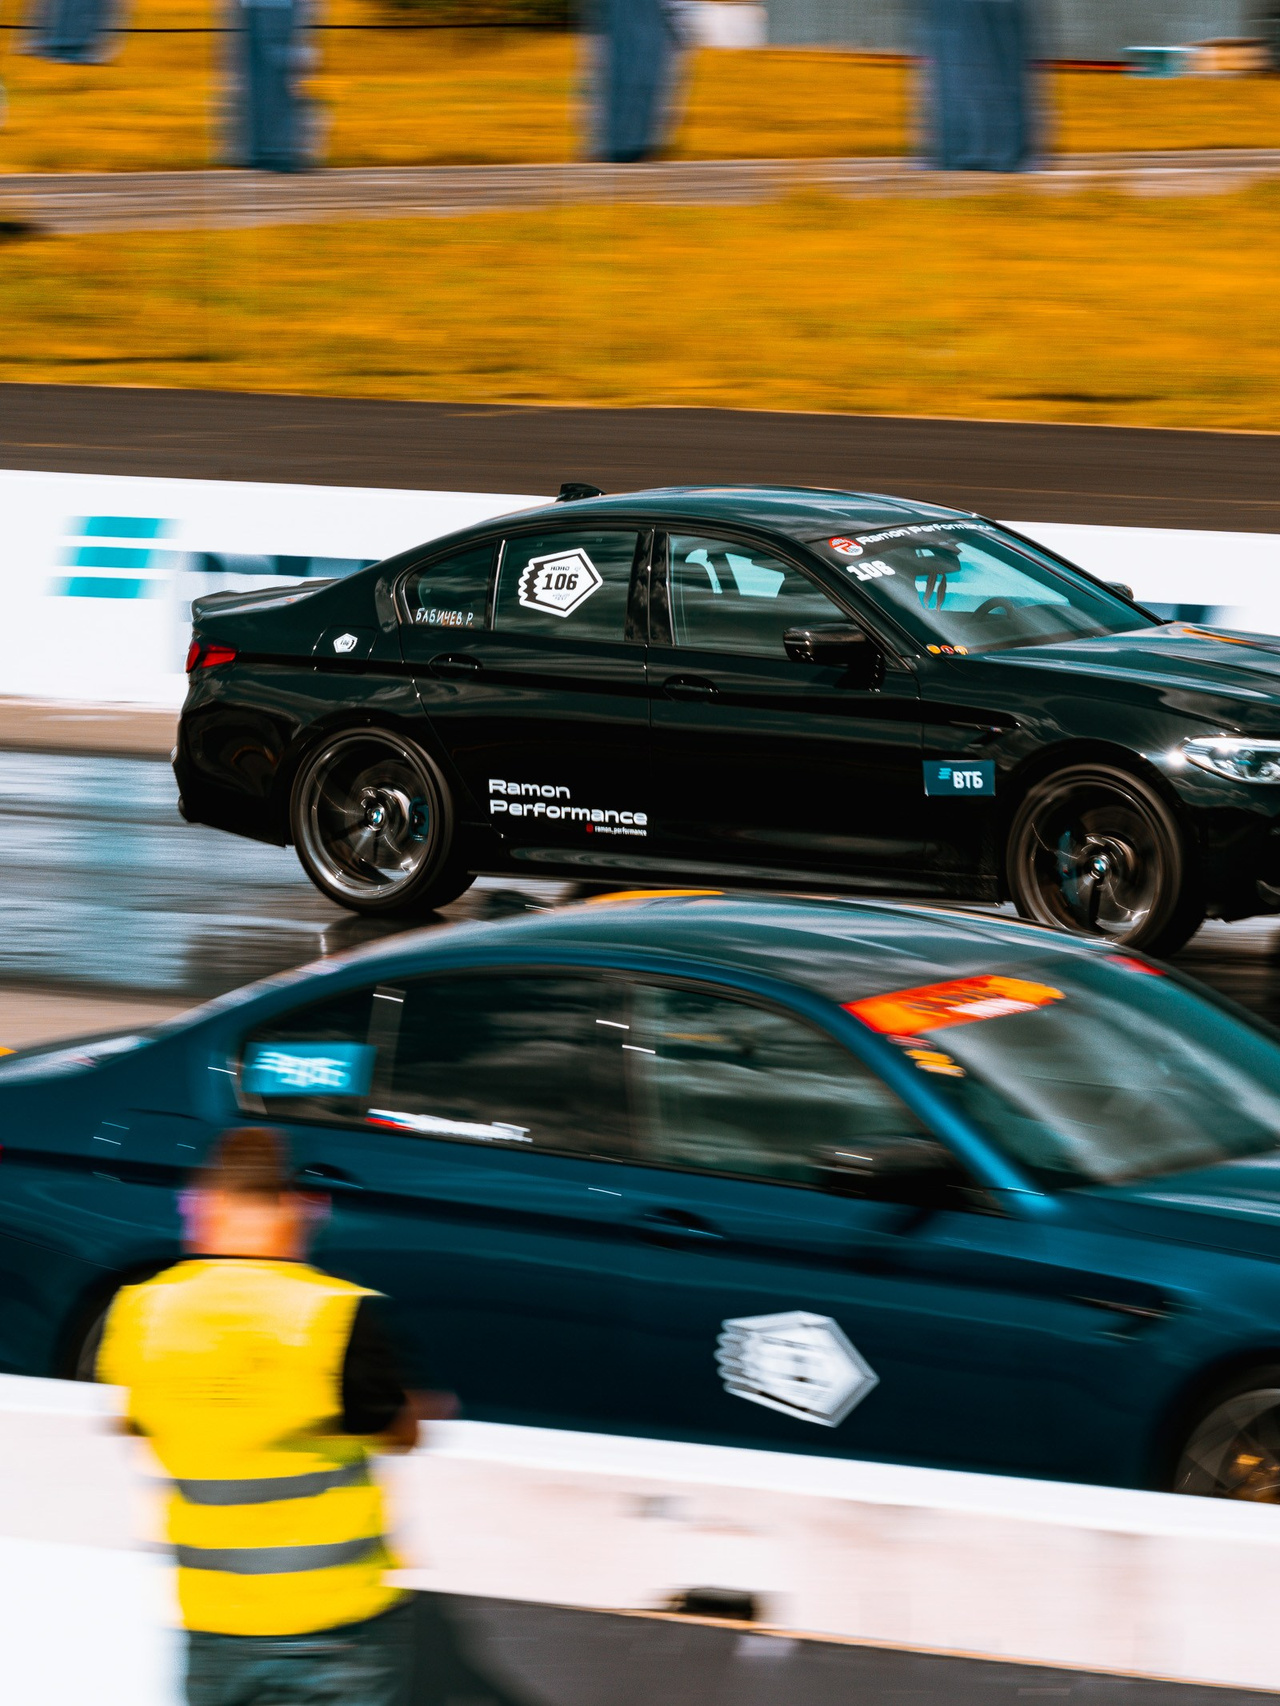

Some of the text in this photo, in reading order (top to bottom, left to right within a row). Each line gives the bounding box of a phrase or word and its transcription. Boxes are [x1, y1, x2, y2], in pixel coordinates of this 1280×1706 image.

[856, 528, 910, 545] Ramon
[846, 560, 896, 582] 106
[542, 573, 579, 590] 106
[488, 778, 571, 799] Ramon
[953, 771, 984, 788] ВТБ
[489, 799, 648, 826] Performance
